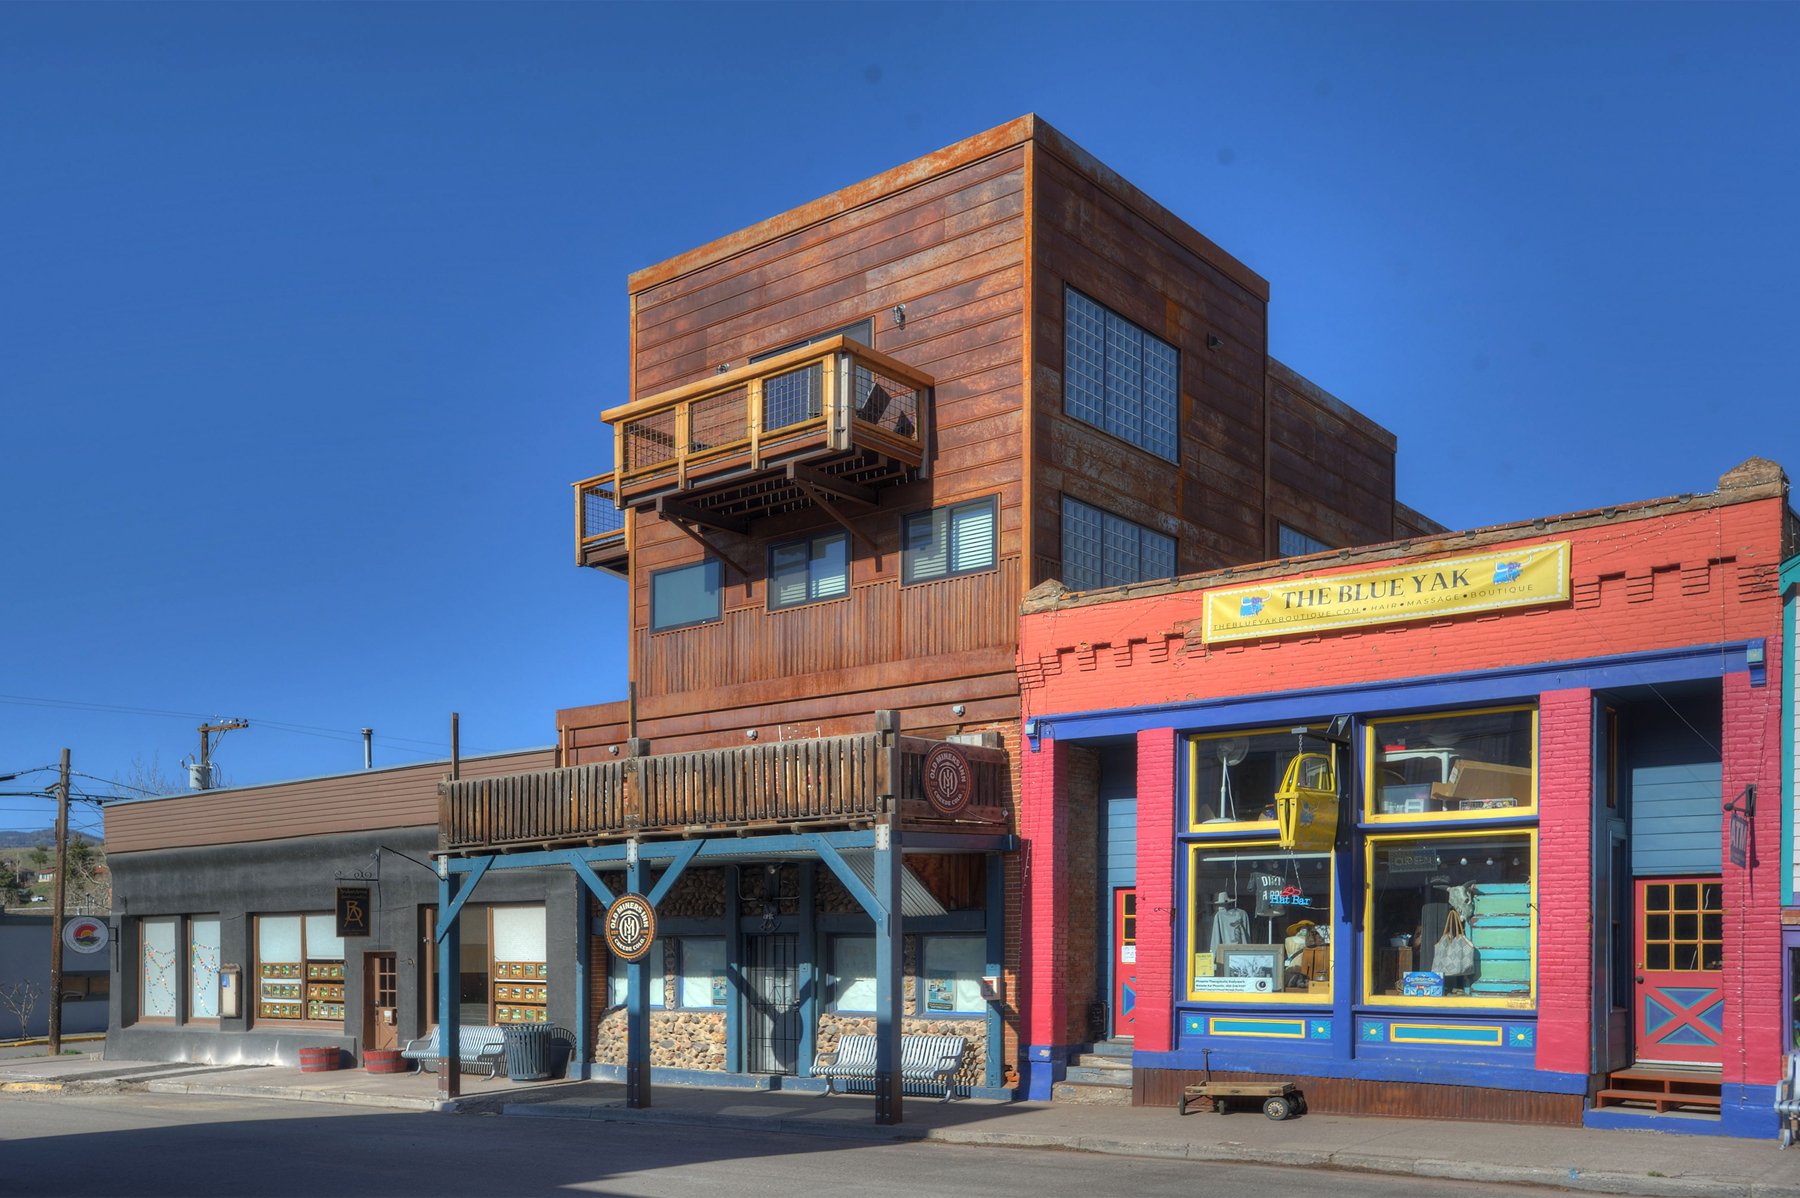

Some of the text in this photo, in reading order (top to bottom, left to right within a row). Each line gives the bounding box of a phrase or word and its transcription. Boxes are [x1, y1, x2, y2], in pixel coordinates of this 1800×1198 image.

[1282, 568, 1471, 610] THE BLUE YAK
[1213, 584, 1534, 631] THEBLUEYAKBOUTIQUE.COM HAIR MASSAGE BOUTIQUE
[936, 753, 960, 766] MINERS
[1731, 818, 1748, 852] ATM
[1270, 894, 1291, 904] Hat
[1291, 894, 1311, 906] Bar
[610, 902, 649, 929] OLD MINERS INN
[614, 938, 632, 951] CREEDE
